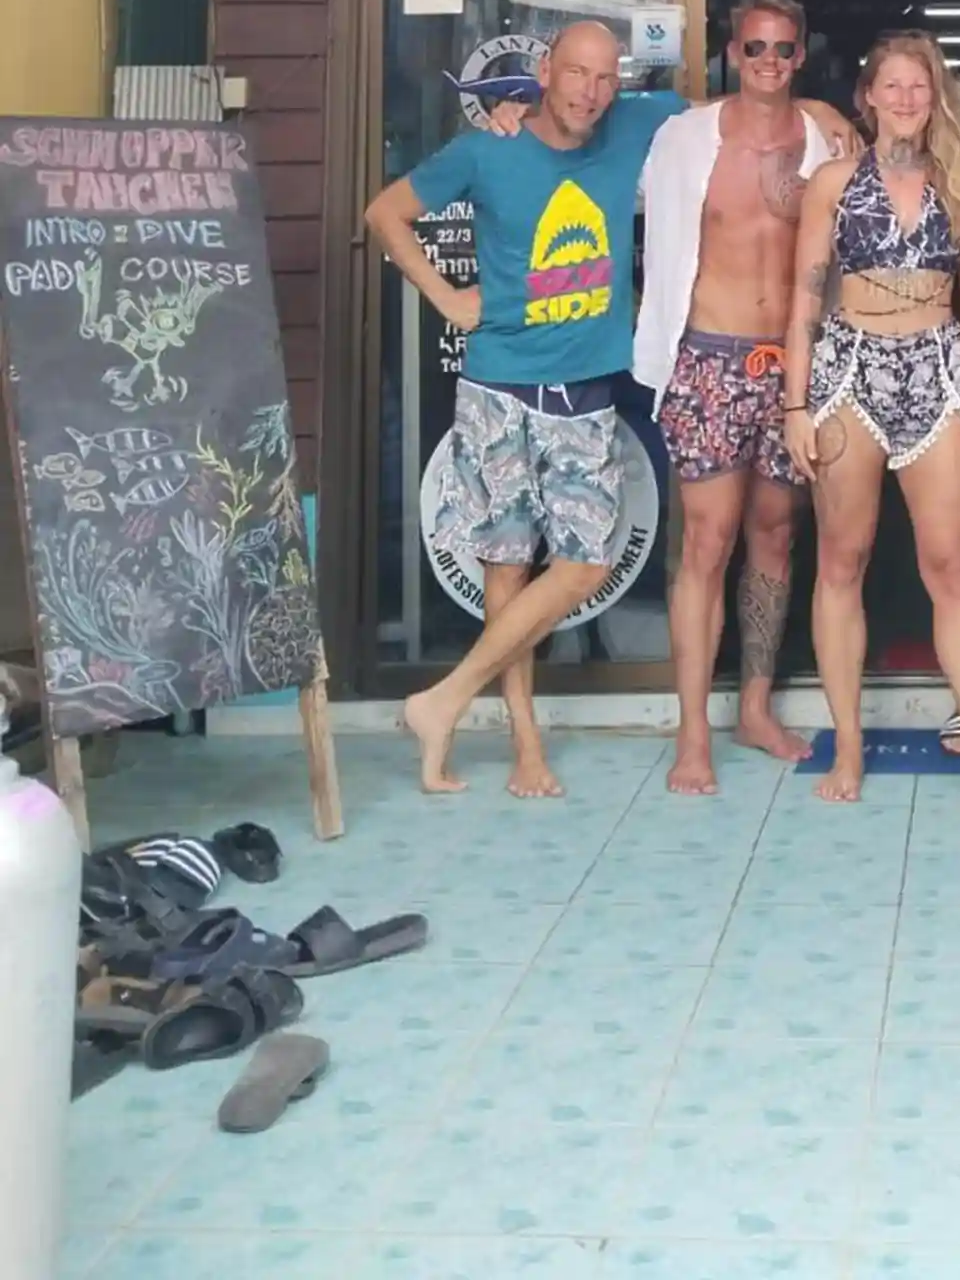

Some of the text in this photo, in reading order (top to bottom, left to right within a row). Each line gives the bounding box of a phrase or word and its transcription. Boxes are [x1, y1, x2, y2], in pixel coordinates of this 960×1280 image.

[26, 217, 105, 248] INTRO
[134, 219, 226, 248] DIVE
[437, 228, 471, 243] 22/3
[120, 256, 251, 286] COURSE
[525, 287, 609, 325] SIDE
[586, 524, 650, 611] EQUIPMENT
